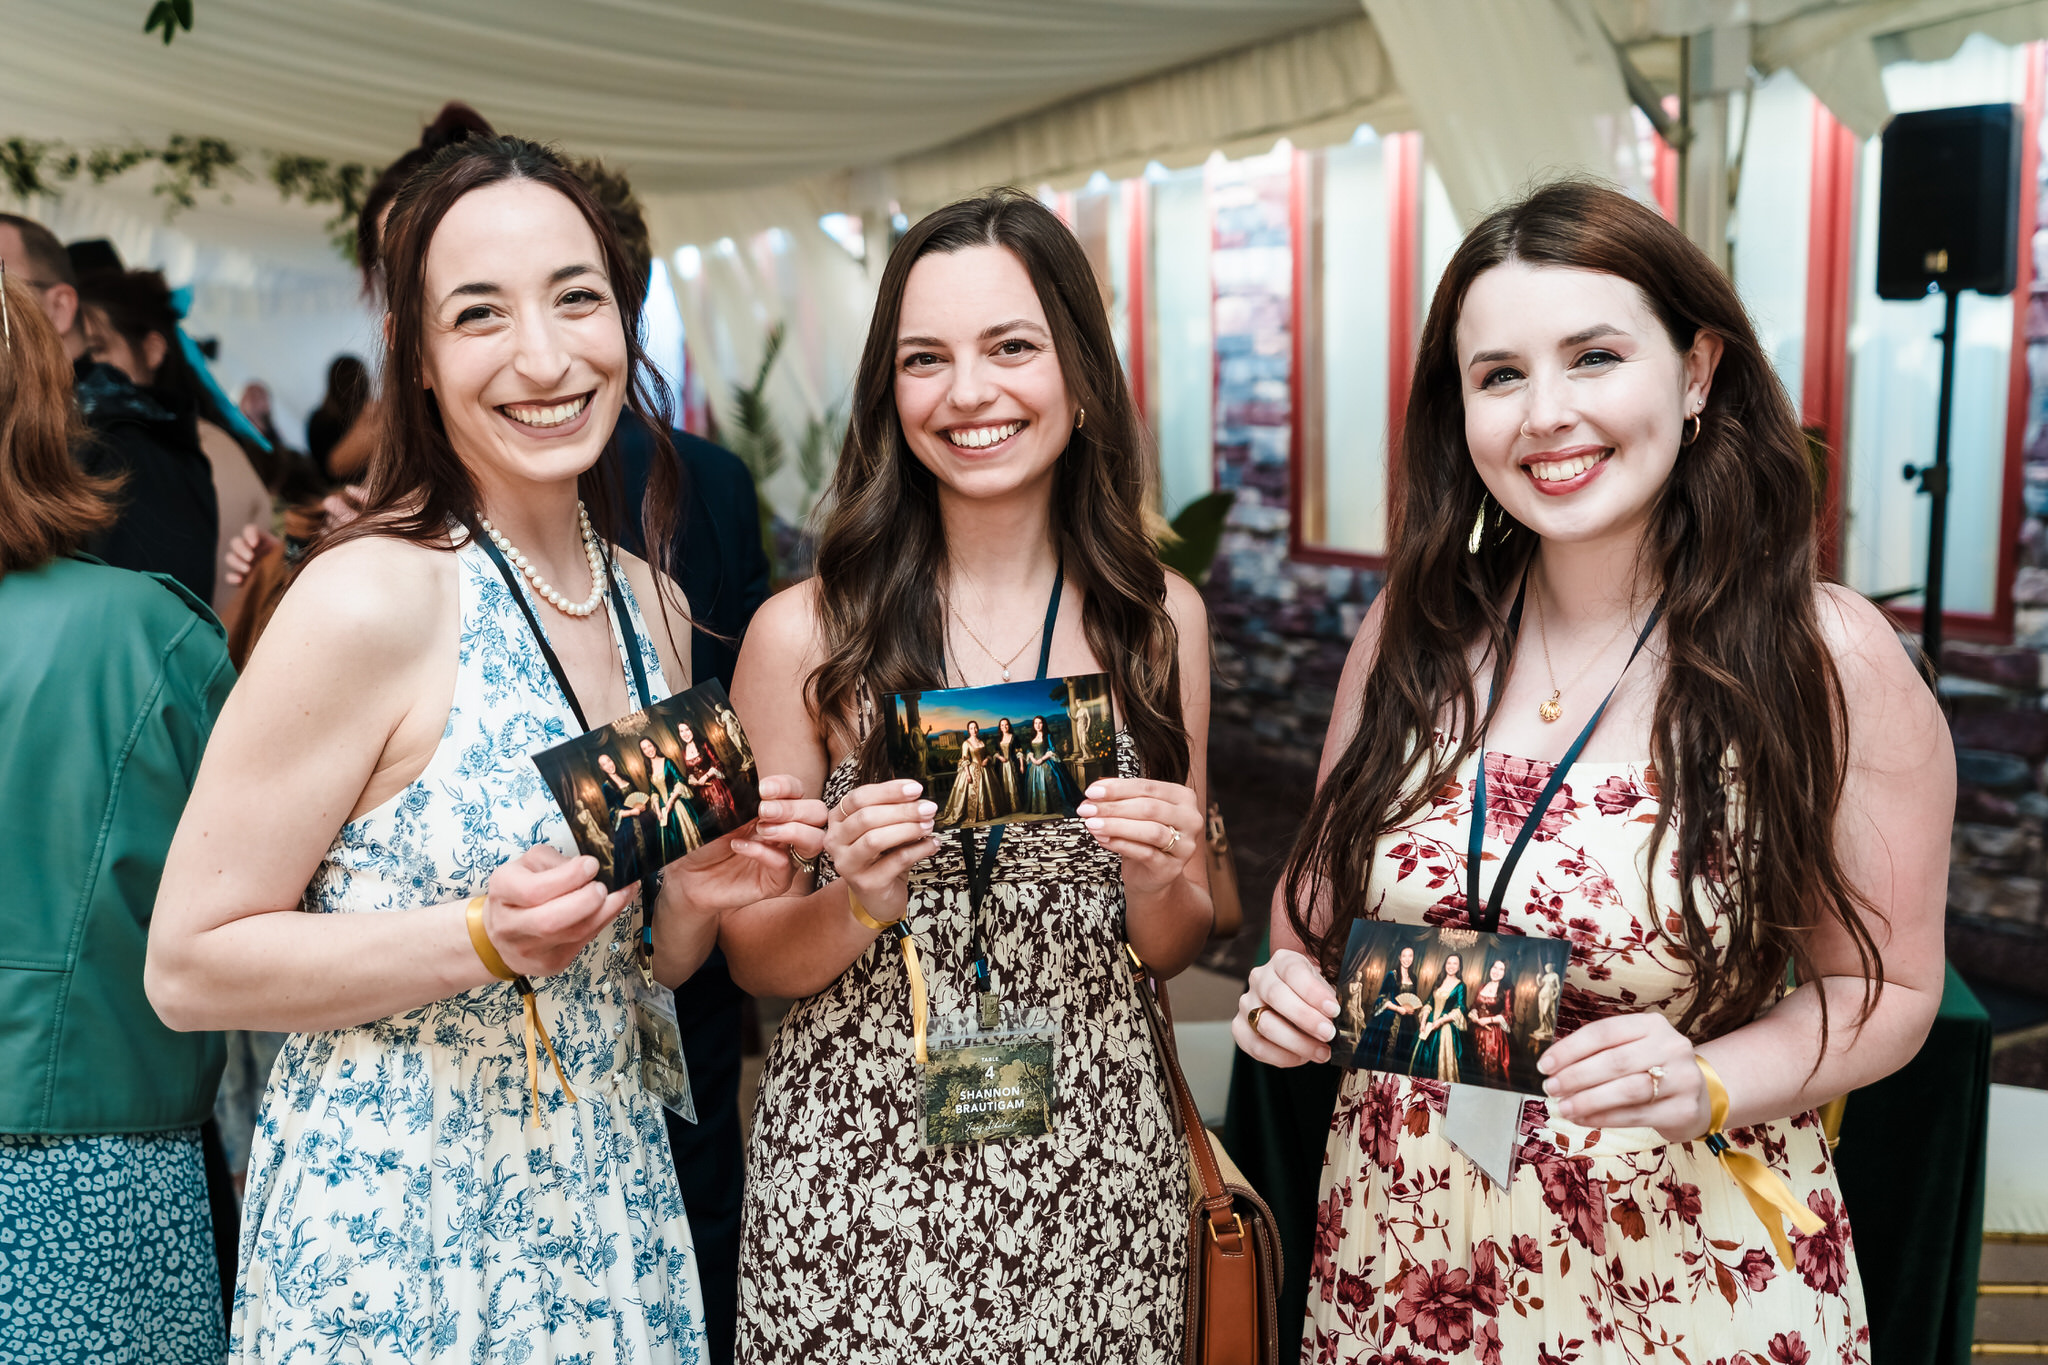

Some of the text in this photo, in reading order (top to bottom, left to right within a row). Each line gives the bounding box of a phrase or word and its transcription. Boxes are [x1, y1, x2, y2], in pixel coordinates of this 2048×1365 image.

[985, 1065, 995, 1079] 4
[960, 1086, 1020, 1100] SHANNON
[955, 1099, 1025, 1114] BRAUTIGAM
